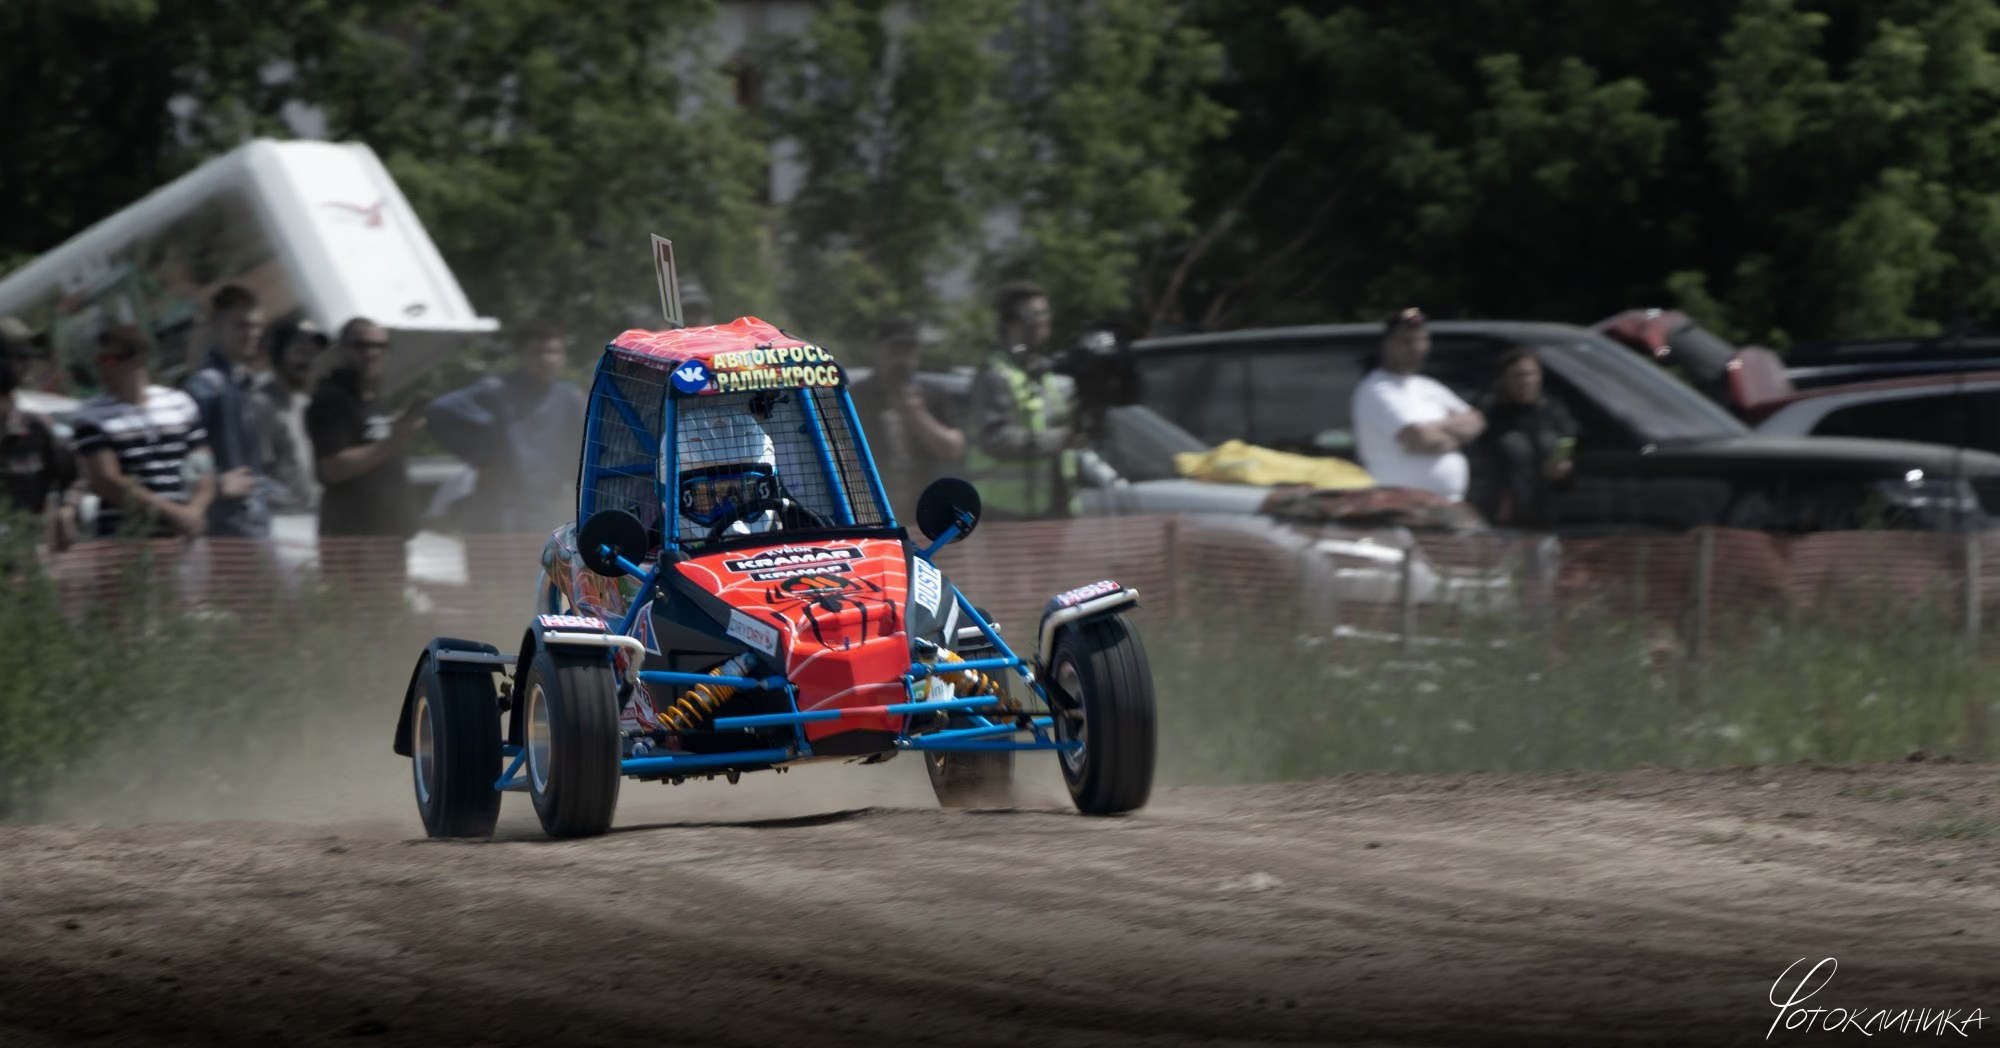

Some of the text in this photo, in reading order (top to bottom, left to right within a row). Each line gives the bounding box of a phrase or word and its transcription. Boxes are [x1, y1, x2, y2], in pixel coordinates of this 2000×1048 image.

[675, 366, 705, 382] VK
[716, 365, 839, 393] РАЛЛИ-КРОСС
[736, 549, 852, 570] KRAMAR
[758, 565, 843, 580] KRAMAR
